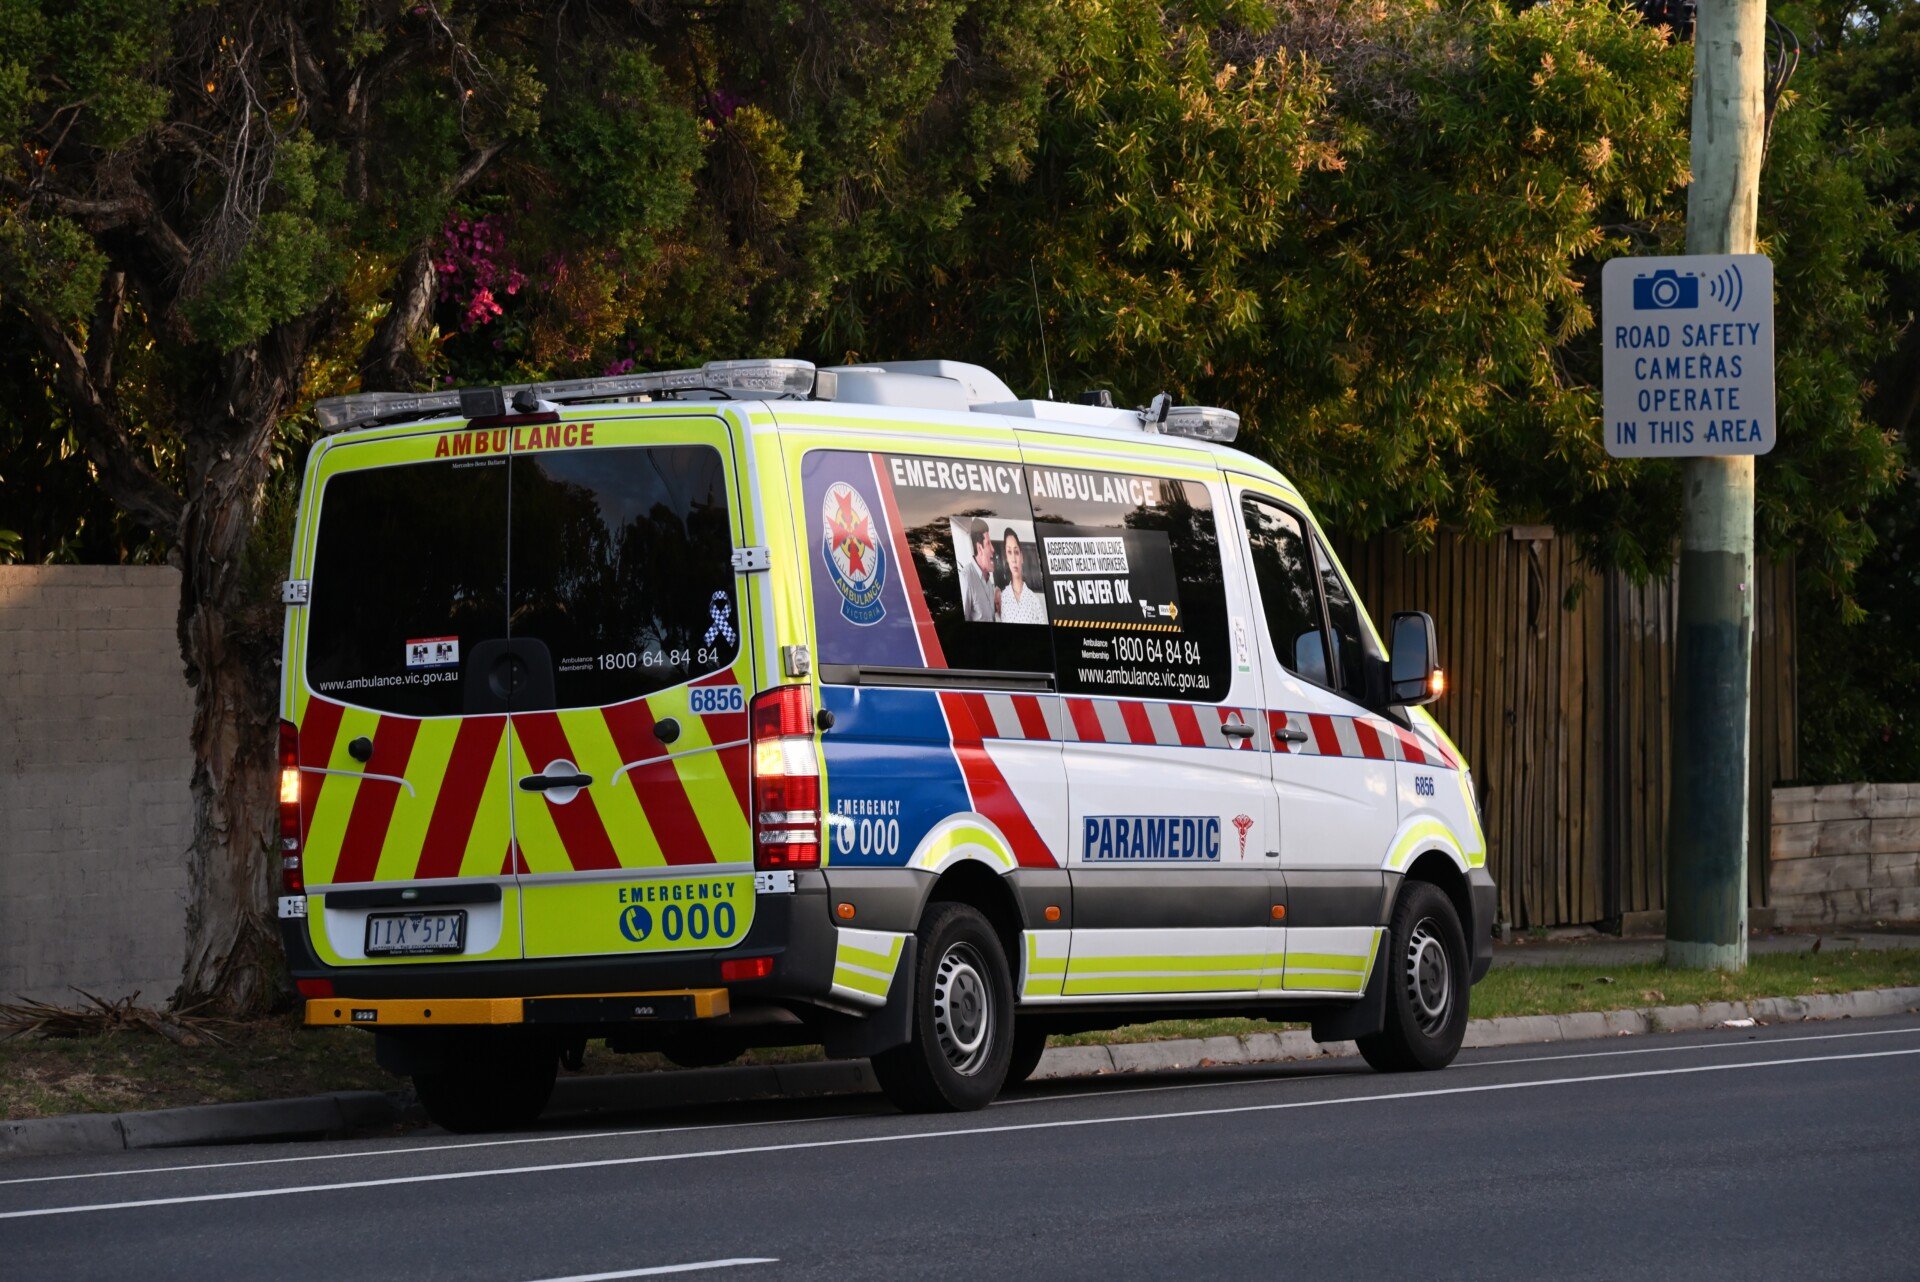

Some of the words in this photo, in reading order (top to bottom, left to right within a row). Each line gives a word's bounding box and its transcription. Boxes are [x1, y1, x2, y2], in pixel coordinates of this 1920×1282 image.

[1616, 325, 1670, 349] ROAD
[1682, 322, 1760, 347] SAFETY
[1635, 355, 1742, 380] CAMERAS
[1638, 387, 1740, 412] OPERATE
[435, 423, 595, 458] AMBULANCE
[1616, 421, 1637, 444] IN
[1648, 420, 1694, 444] THIS
[1706, 419, 1762, 443] AREA
[890, 458, 1023, 494] EMERGENCY
[1033, 470, 1156, 506] AMBULANCE
[1047, 541, 1085, 555] AGGRESSION
[1085, 541, 1096, 555] AND
[1096, 541, 1123, 555] VIOLENCE
[1050, 558, 1075, 572] AGAINST
[1075, 558, 1097, 571] HEALTH
[837, 578, 881, 605] AMBULANCE
[1053, 580, 1076, 605] IT'S
[1077, 580, 1114, 605] NEVER
[1114, 579, 1132, 603] OK
[846, 607, 880, 620] VICTORIA
[1081, 649, 1109, 661] Membership
[1082, 638, 1108, 648] Ambulance
[1112, 636, 1144, 662] 1800
[1146, 638, 1163, 662] 64
[1165, 639, 1182, 664] 84
[1184, 640, 1200, 665] 84
[558, 663, 594, 672] Membership
[561, 656, 593, 664] Ambulance
[597, 652, 637, 671] 1800
[643, 651, 664, 667] 64
[670, 649, 691, 666] 84
[697, 647, 719, 664] 84
[320, 671, 459, 691] www.ambulance.vic.gov.au
[1078, 666, 1210, 693] www.ambulance.vic.gov.au
[690, 687, 743, 712] 6856
[1415, 776, 1435, 796] 6856
[837, 799, 900, 816] EMERGENCY
[860, 818, 899, 855] 000
[1085, 818, 1219, 859] PARAMEDIC
[619, 882, 735, 903] EMERGENCY
[662, 901, 736, 941] 000
